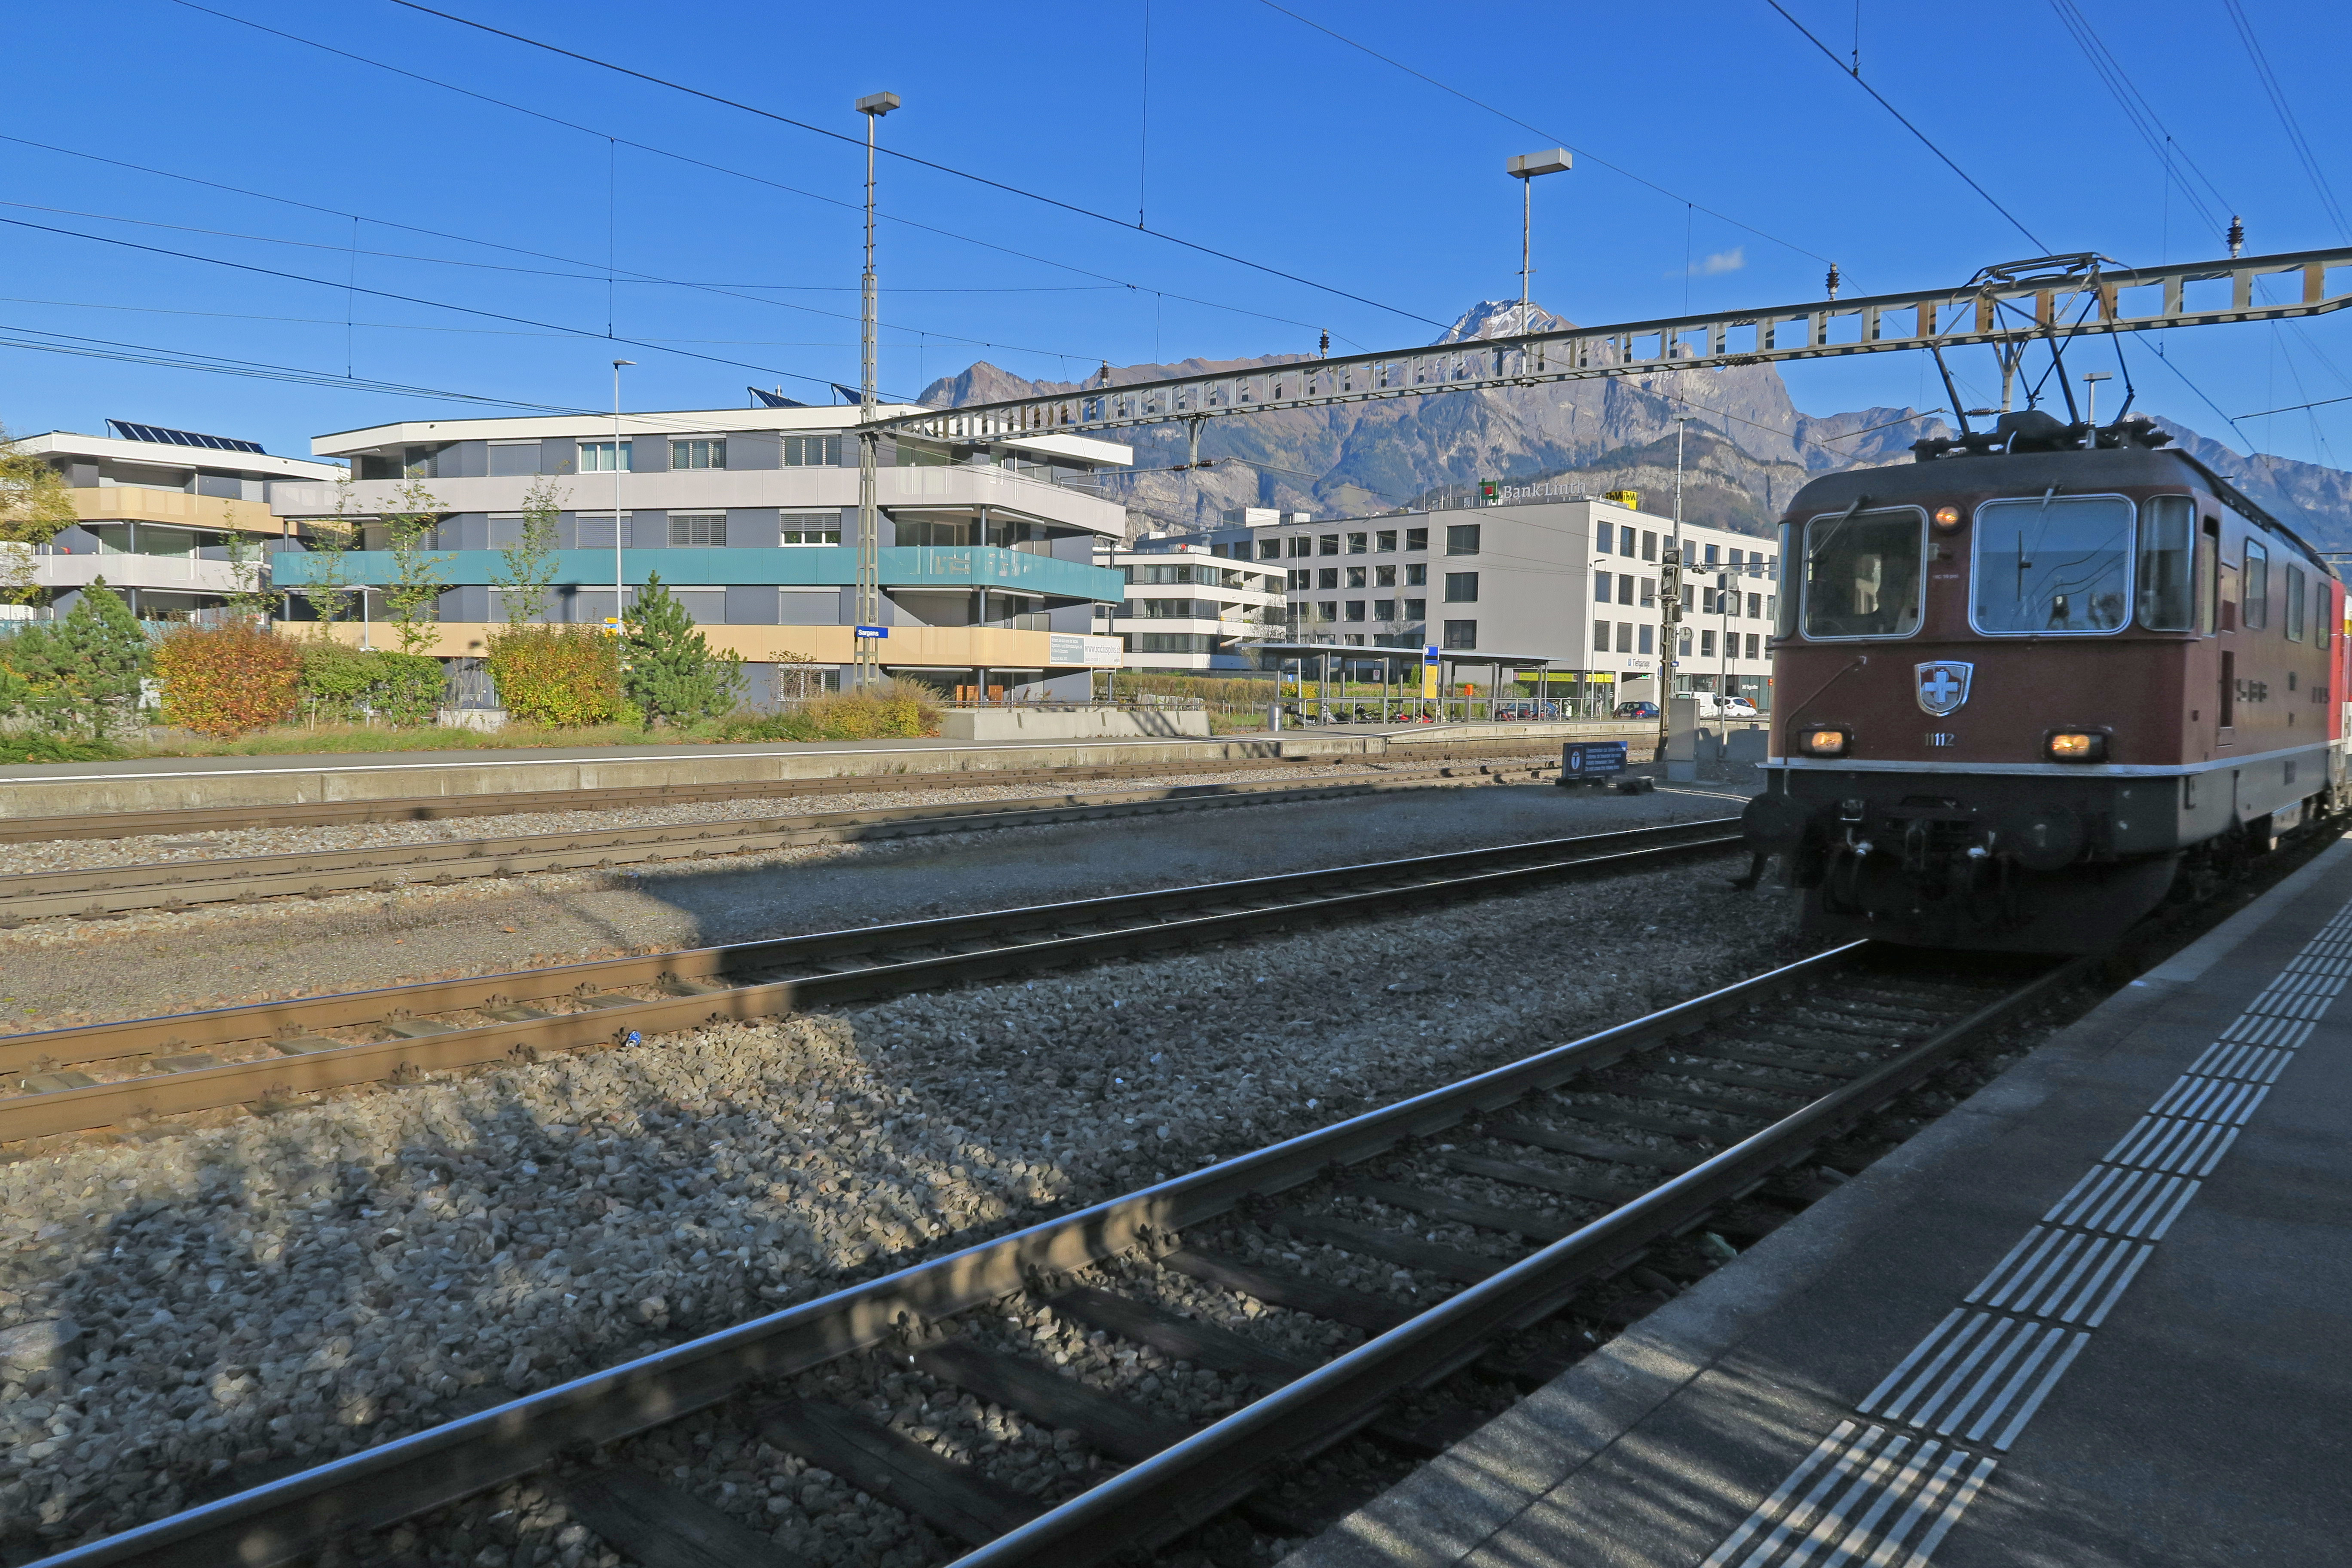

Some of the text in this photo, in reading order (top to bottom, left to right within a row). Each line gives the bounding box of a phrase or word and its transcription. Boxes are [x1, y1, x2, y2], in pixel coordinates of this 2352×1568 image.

[1504, 481, 1587, 499] Bank Linth
[858, 629, 879, 637] Sargans
[1085, 645, 1121, 655] www.radiusplus.ch
[1632, 659, 1650, 669] Tiefgarage
[1925, 733, 1954, 746] 11112
